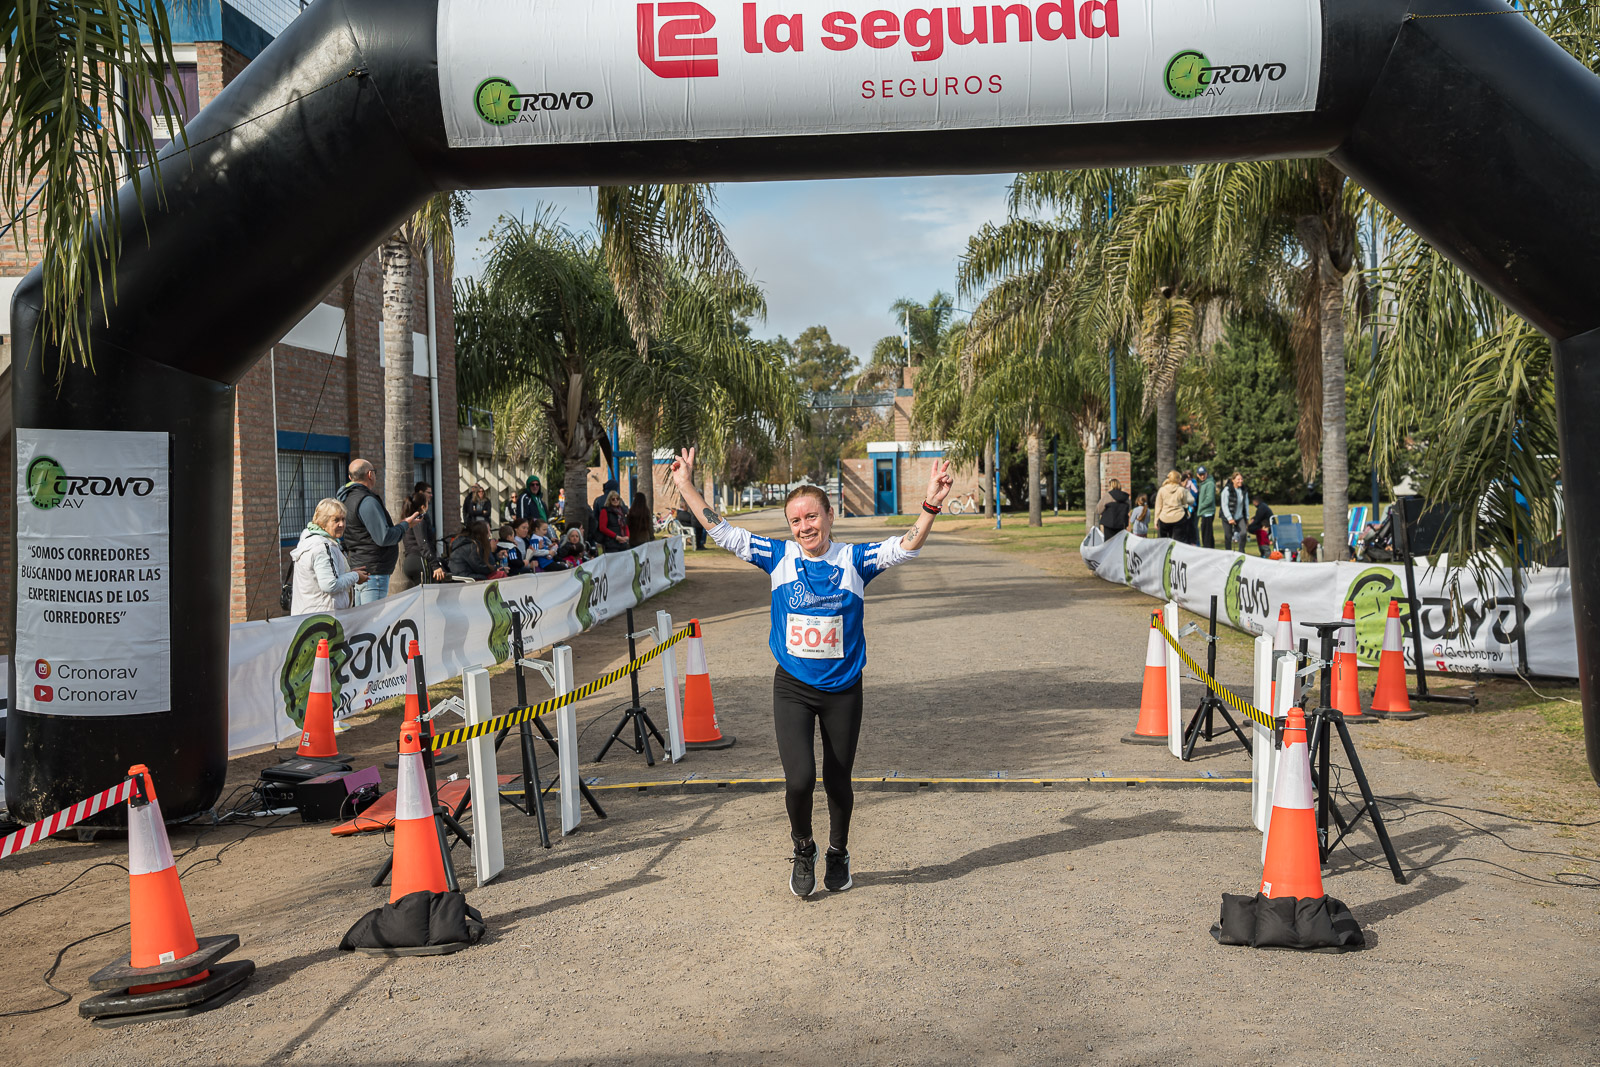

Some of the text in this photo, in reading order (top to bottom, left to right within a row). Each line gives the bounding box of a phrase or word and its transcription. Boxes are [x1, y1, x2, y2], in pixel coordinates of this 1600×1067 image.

[742, 2, 804, 53] la
[820, 0, 1120, 62] segunda
[1198, 62, 1287, 85] CRONO
[861, 74, 1003, 99] SEGUROS
[1195, 86, 1226, 97] RAV
[507, 91, 594, 112] CRONO
[507, 114, 538, 124] RAV
[53, 476, 155, 497] CRONO
[51, 498, 84, 509] RAV
[67, 547, 150, 561] CORREDORES
[21, 565, 161, 582] BUSCANDO MEJORAR LAS
[28, 587, 150, 603] EXPERIENCIAS DE LOS
[789, 625, 839, 648] 504
[58, 664, 138, 680] Cronorav
[58, 686, 138, 702] Cronorav
